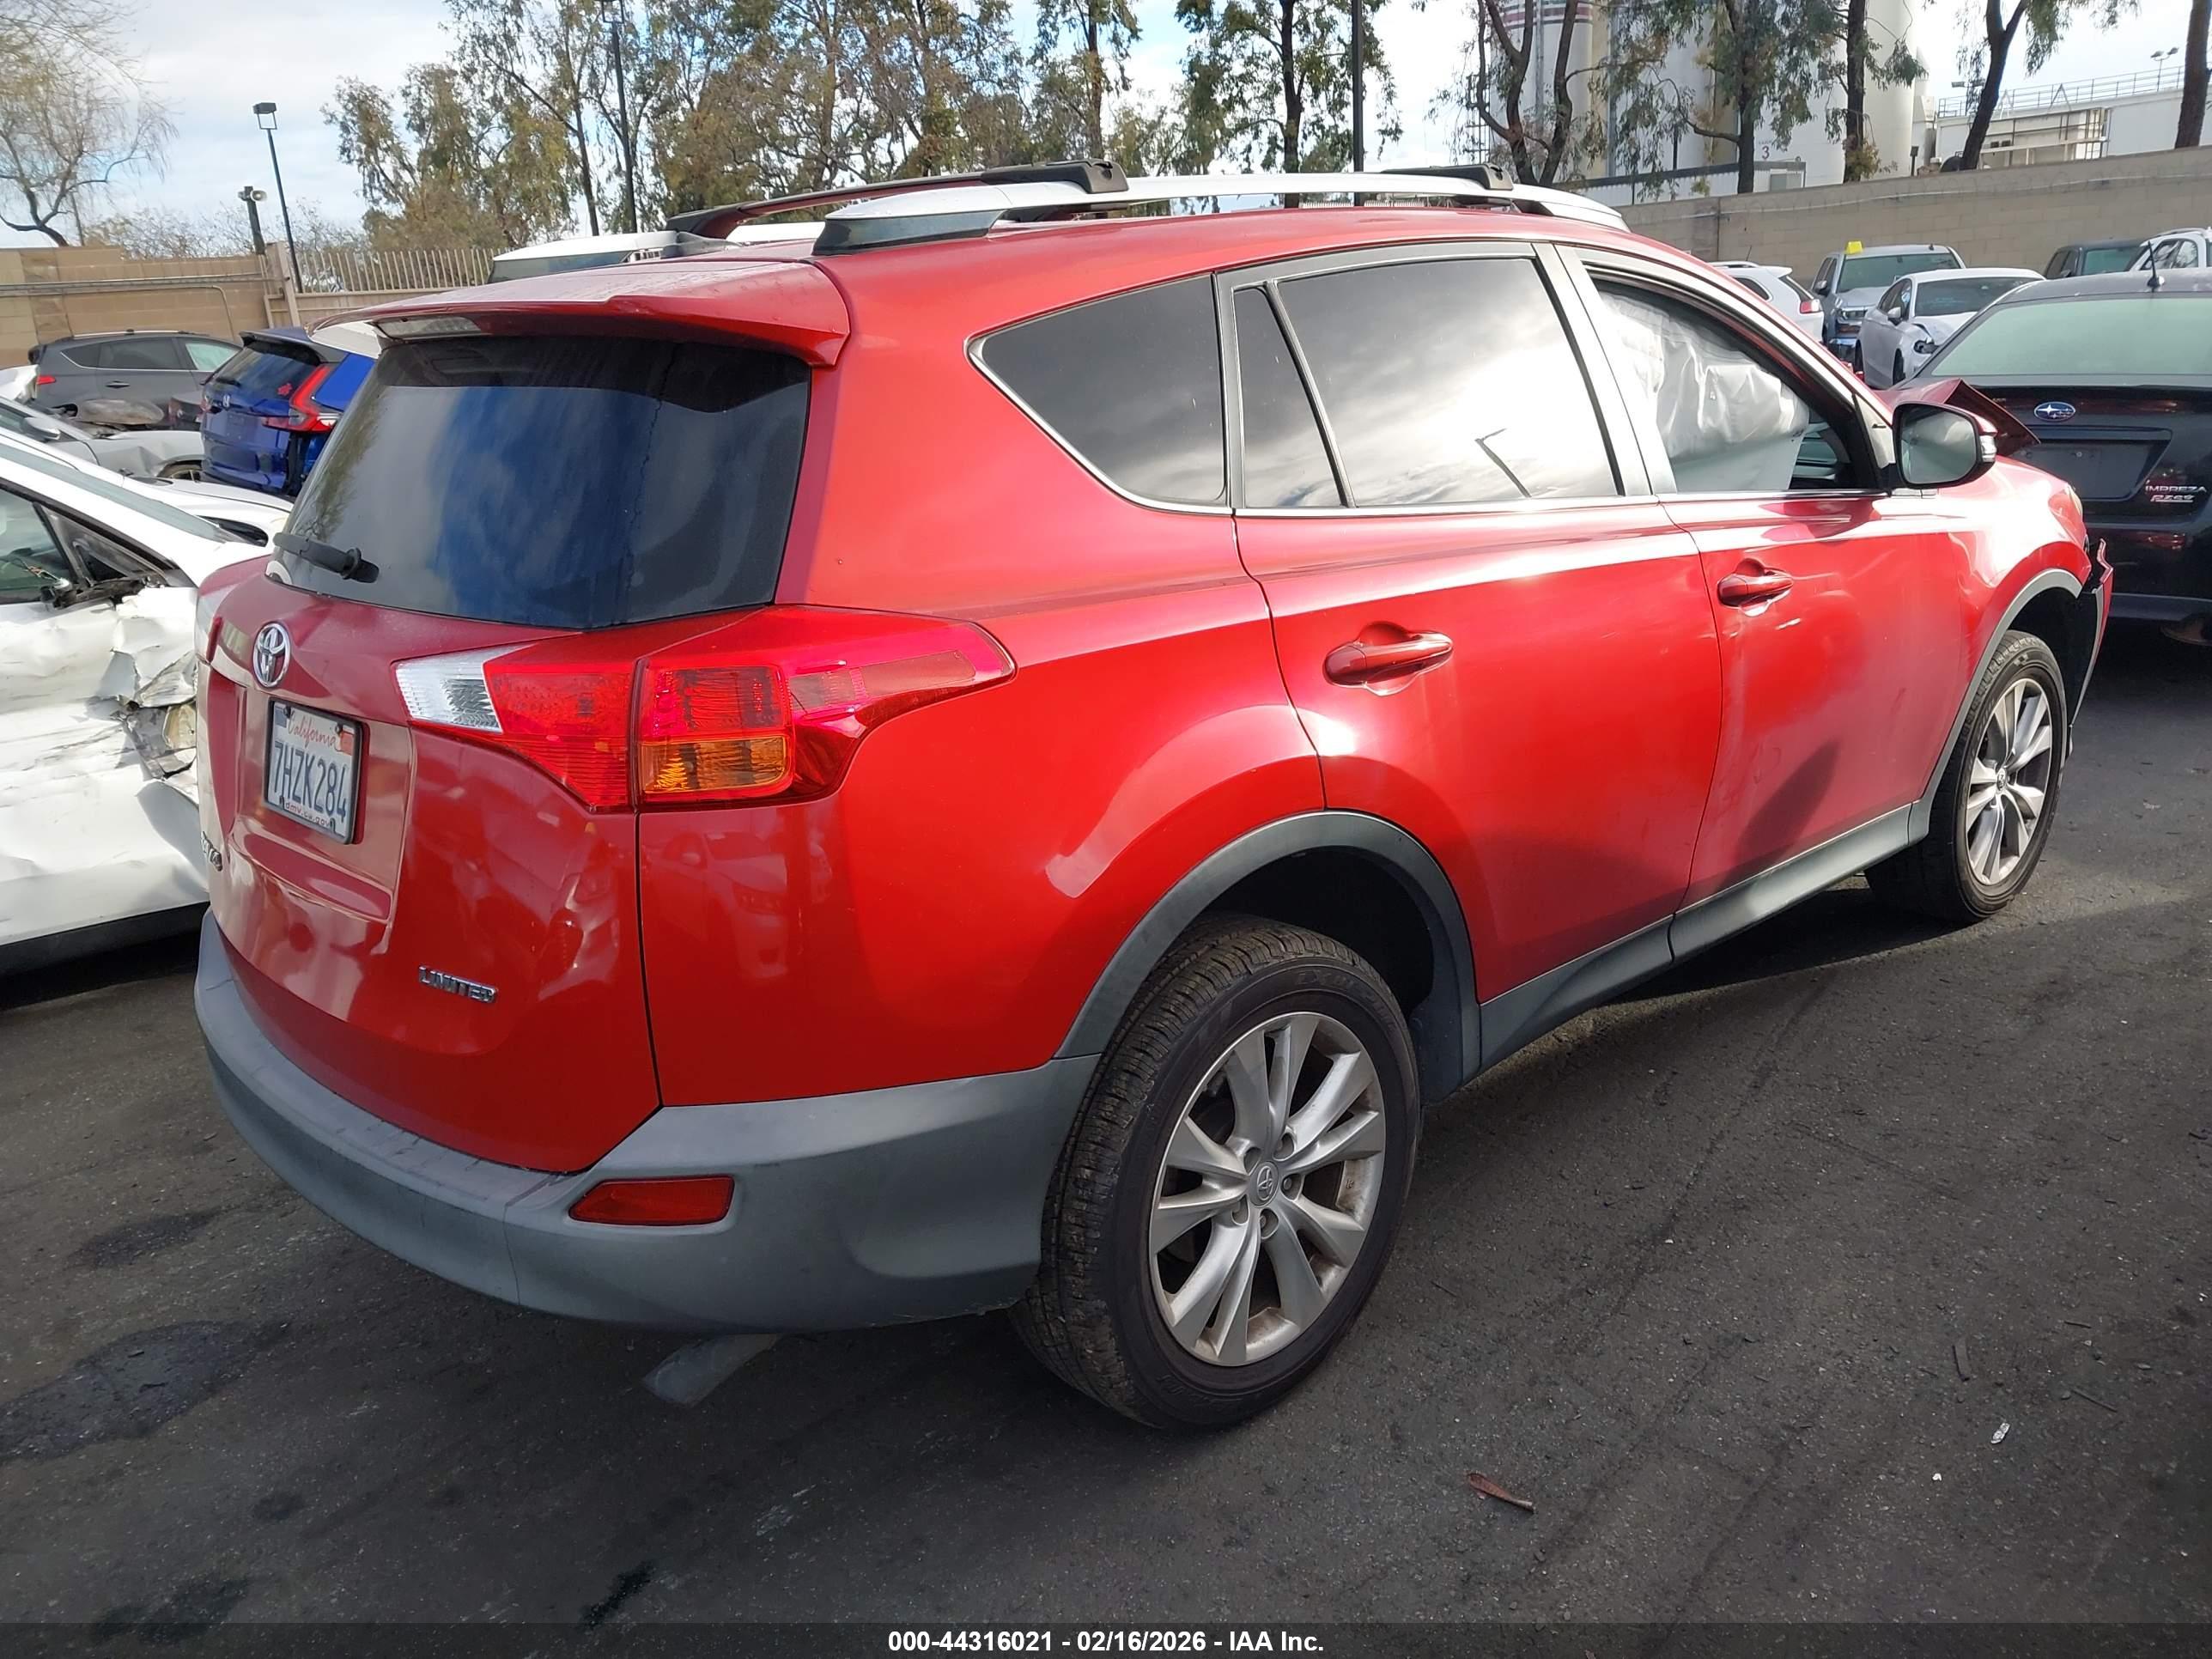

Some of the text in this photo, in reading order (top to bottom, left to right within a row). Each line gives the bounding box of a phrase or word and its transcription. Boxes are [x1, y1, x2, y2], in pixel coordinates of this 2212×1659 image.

[1761, 145, 1771, 161] 3
[2145, 485, 2207, 494] IMPREZA
[287, 709, 337, 749] California
[273, 739, 348, 823] 7HZK284
[418, 965, 496, 1003] LIMITED
